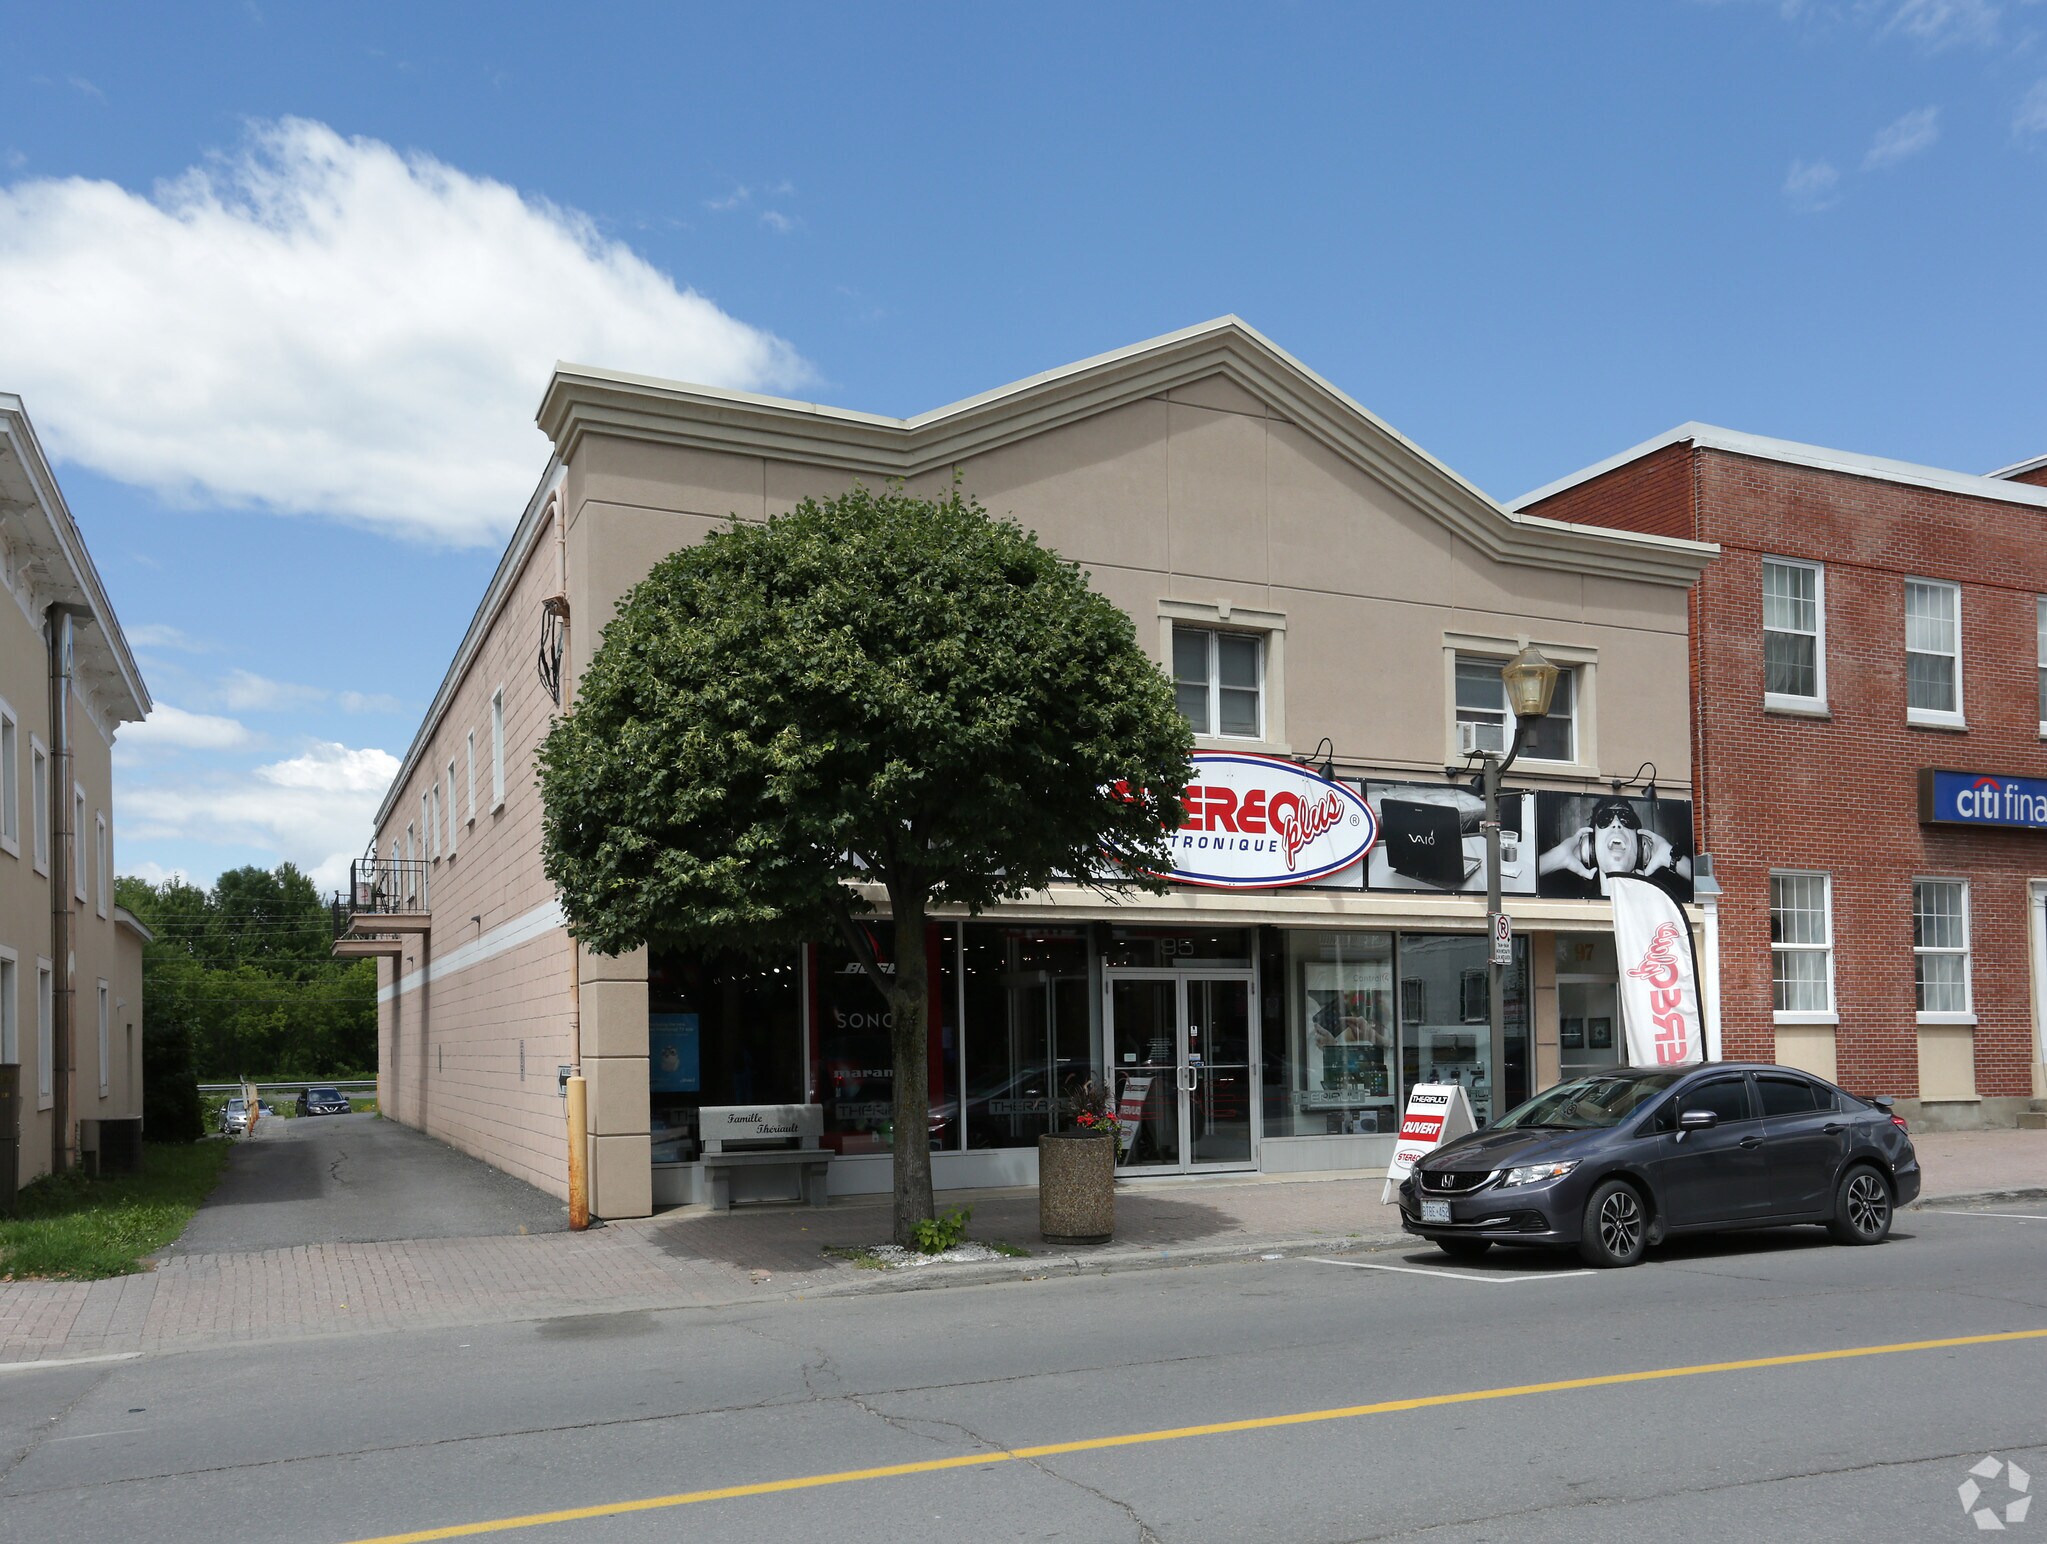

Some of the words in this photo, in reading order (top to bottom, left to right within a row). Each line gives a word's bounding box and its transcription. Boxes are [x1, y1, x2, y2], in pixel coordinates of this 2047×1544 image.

[1957, 784, 1999, 819] citi
[1283, 791, 1345, 871] plus
[1408, 829, 1435, 846] VAIO
[1146, 834, 1278, 853] TRONIQUE
[1160, 938, 1194, 955] 95
[1574, 943, 1595, 961] 97
[727, 1113, 763, 1124] Famille
[1402, 1121, 1441, 1135] OUVERT
